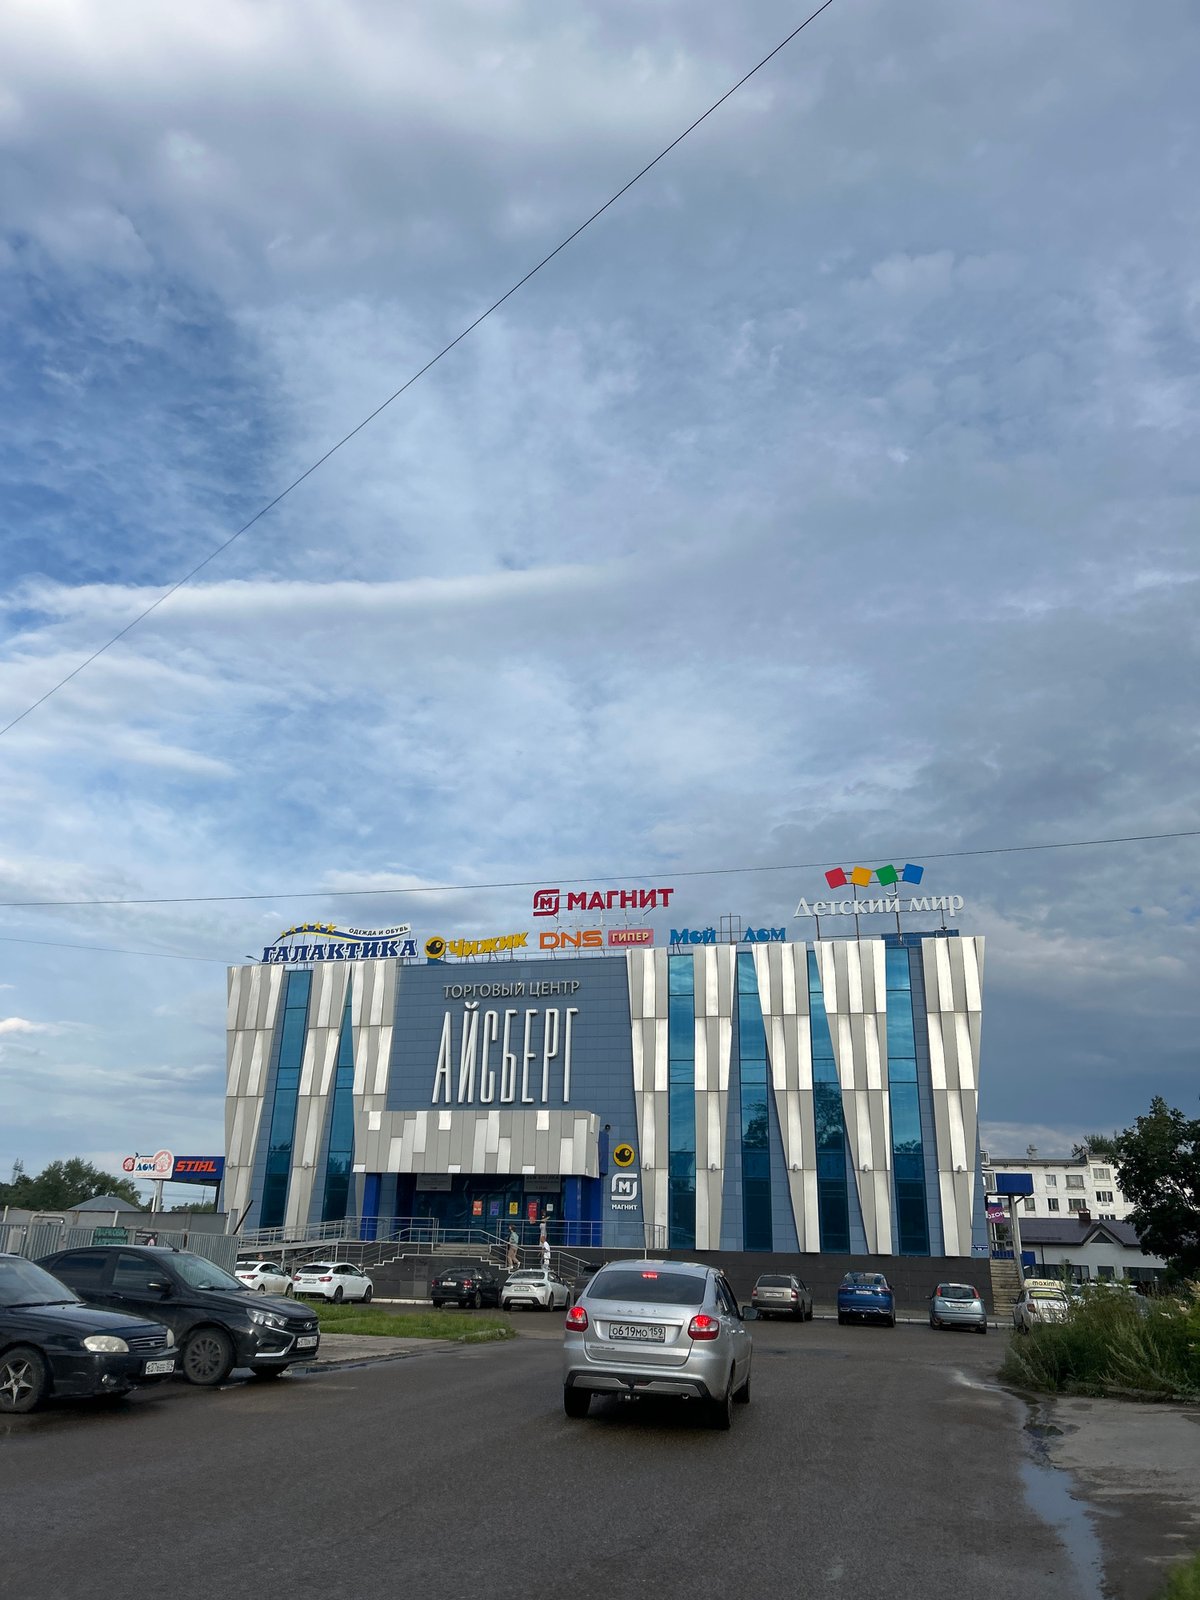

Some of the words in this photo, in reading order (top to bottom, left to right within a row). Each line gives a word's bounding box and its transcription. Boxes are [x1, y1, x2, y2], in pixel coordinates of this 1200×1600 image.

[567, 888, 675, 911] МАГНИТ
[793, 890, 901, 919] Детский
[909, 894, 965, 918] мир
[348, 927, 377, 937] ОДЕЖДА
[385, 925, 409, 936] ОБУВЬ
[539, 930, 603, 949] DNS
[611, 931, 650, 944] ГИПЕР
[261, 938, 418, 963] ГАЛАКТИКА
[443, 982, 526, 999] ТОРГОВЫЙ
[529, 980, 580, 997] ЦЕНТР
[431, 1001, 580, 1104] АЙСБЕРГ
[175, 1160, 217, 1172] STIHL
[649, 1327, 663, 1336] 159
